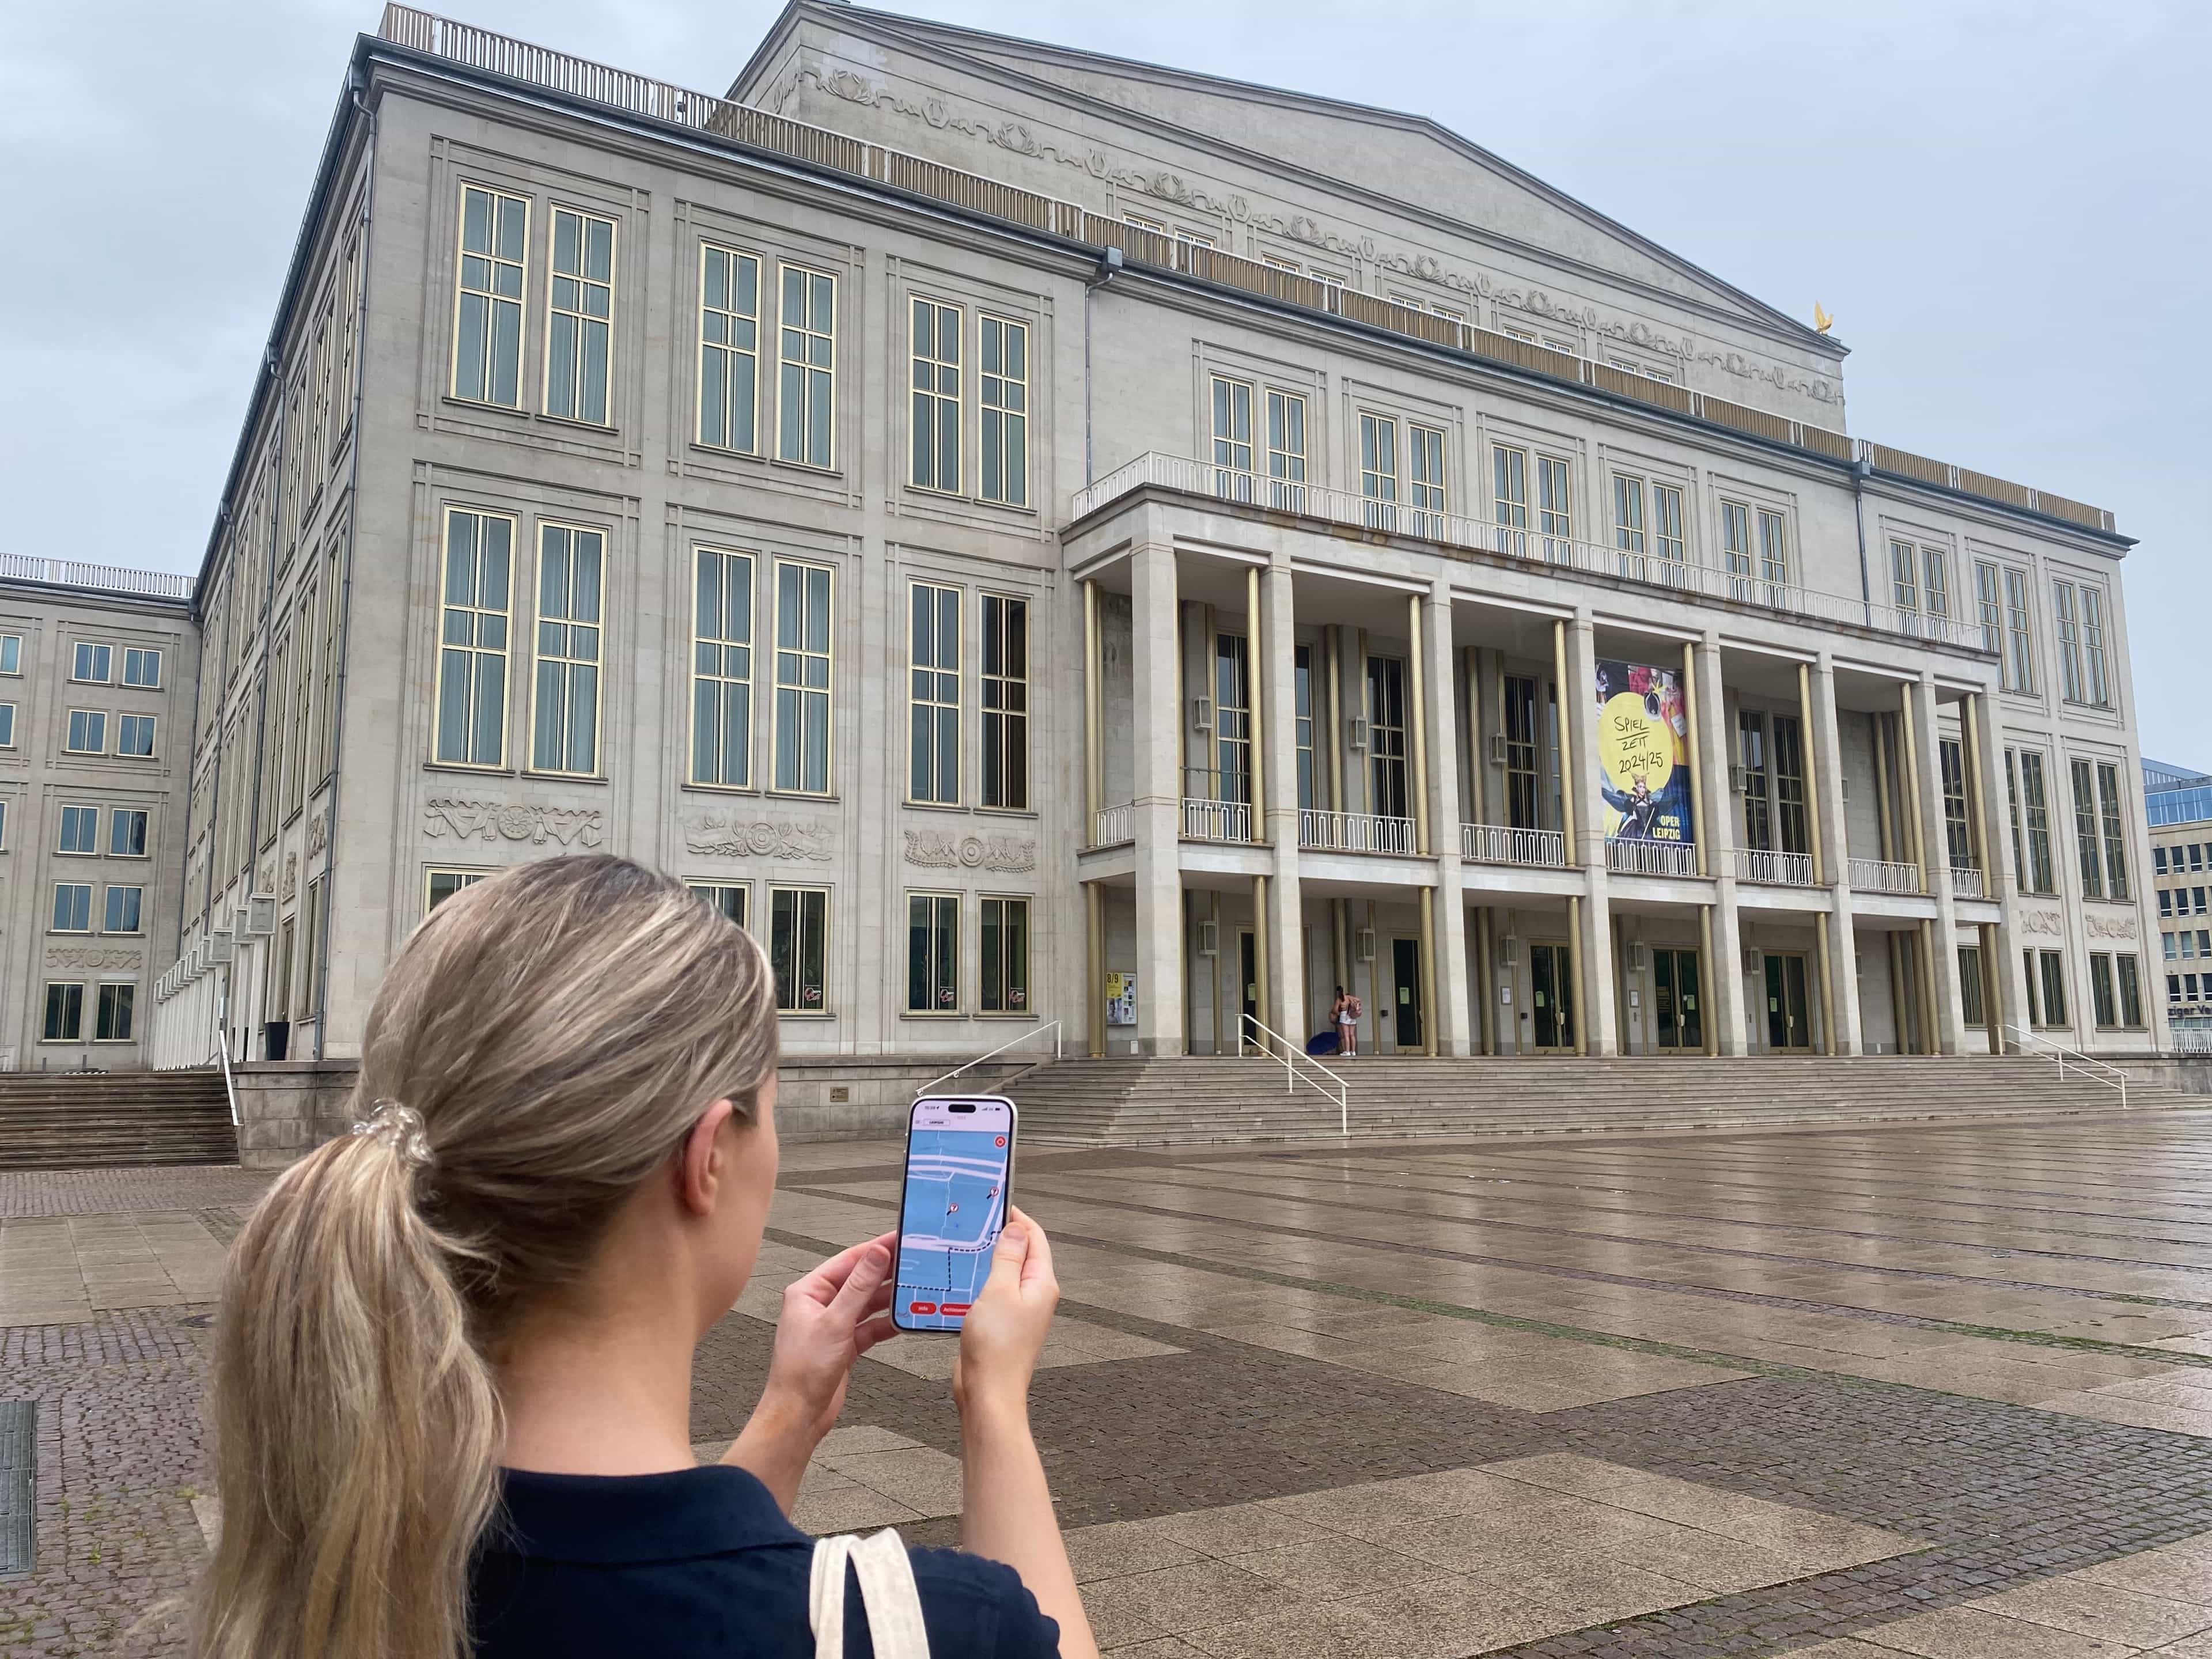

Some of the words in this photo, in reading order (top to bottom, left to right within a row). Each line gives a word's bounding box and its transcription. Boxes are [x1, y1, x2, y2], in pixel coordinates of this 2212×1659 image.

[1614, 716, 1650, 732] SPIEL
[1660, 815, 1680, 827] OPER
[1652, 827, 1681, 840] LEIPZIG
